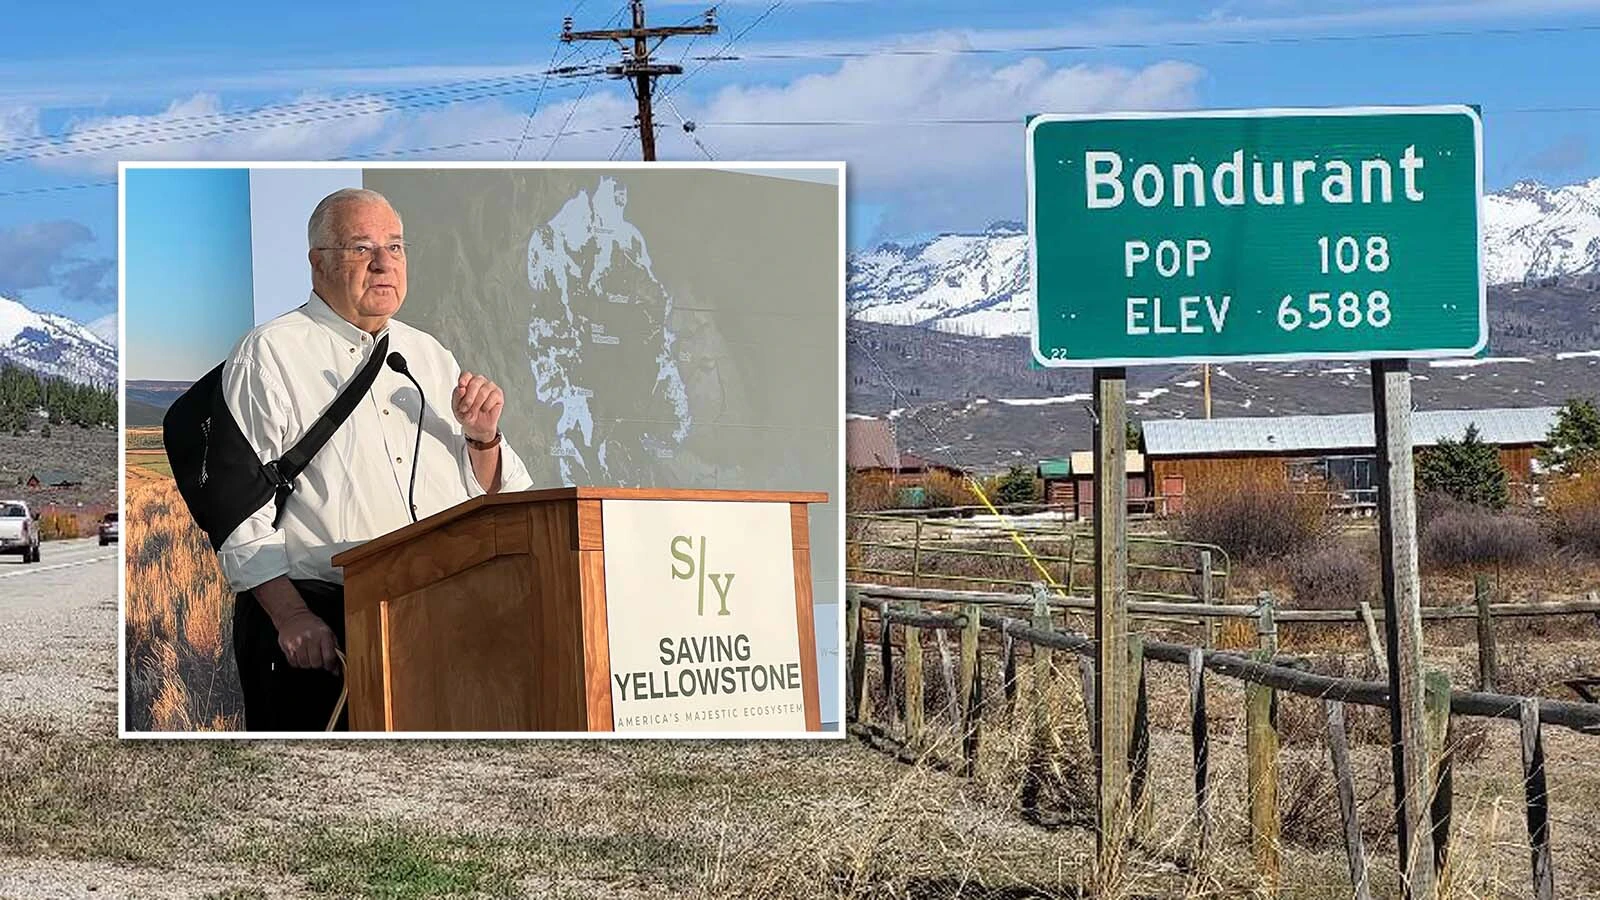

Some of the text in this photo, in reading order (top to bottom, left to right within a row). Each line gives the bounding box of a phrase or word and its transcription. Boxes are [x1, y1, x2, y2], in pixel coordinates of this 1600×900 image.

[1084, 144, 1425, 210] Bondurant
[1124, 235, 1391, 278] POP 108
[1126, 290, 1392, 335] ELEV 6588
[659, 634, 751, 666] SAVING
[614, 663, 801, 702] YELLOWSTONE
[618, 703, 803, 728] AMERICA'S MAJESTIC ECOSYSTEM
